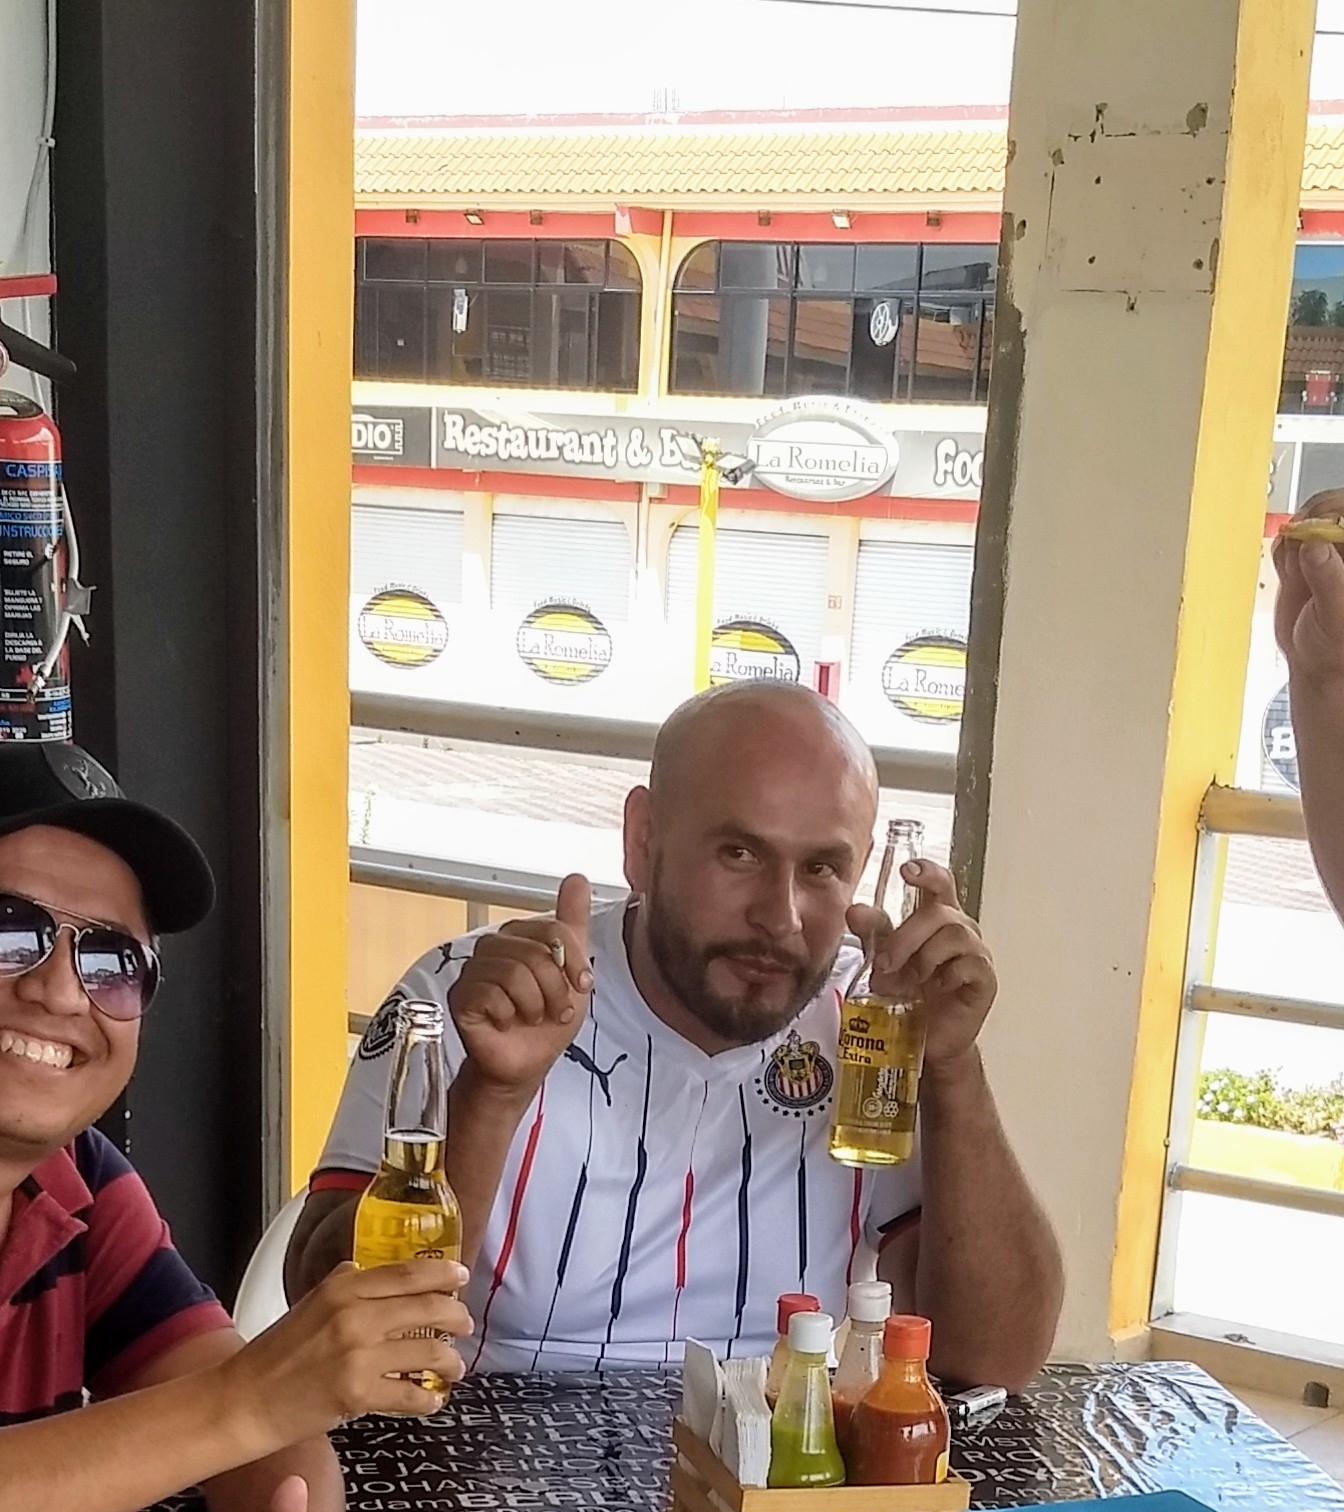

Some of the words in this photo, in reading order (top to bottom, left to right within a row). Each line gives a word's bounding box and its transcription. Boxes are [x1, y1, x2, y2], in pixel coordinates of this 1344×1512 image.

[444, 411, 618, 468] Restaurant
[626, 427, 653, 468] &
[755, 444, 781, 468] La
[788, 446, 880, 474] Romelia
[934, 438, 984, 487] Foo
[543, 633, 609, 662] Romelia
[709, 660, 722, 672] a
[915, 668, 966, 697] Rome
[839, 1027, 885, 1052] Corona
[843, 1047, 872, 1064] Extra
[451, 1388, 555, 1400] EIRO
[565, 1388, 685, 1400] TOK
